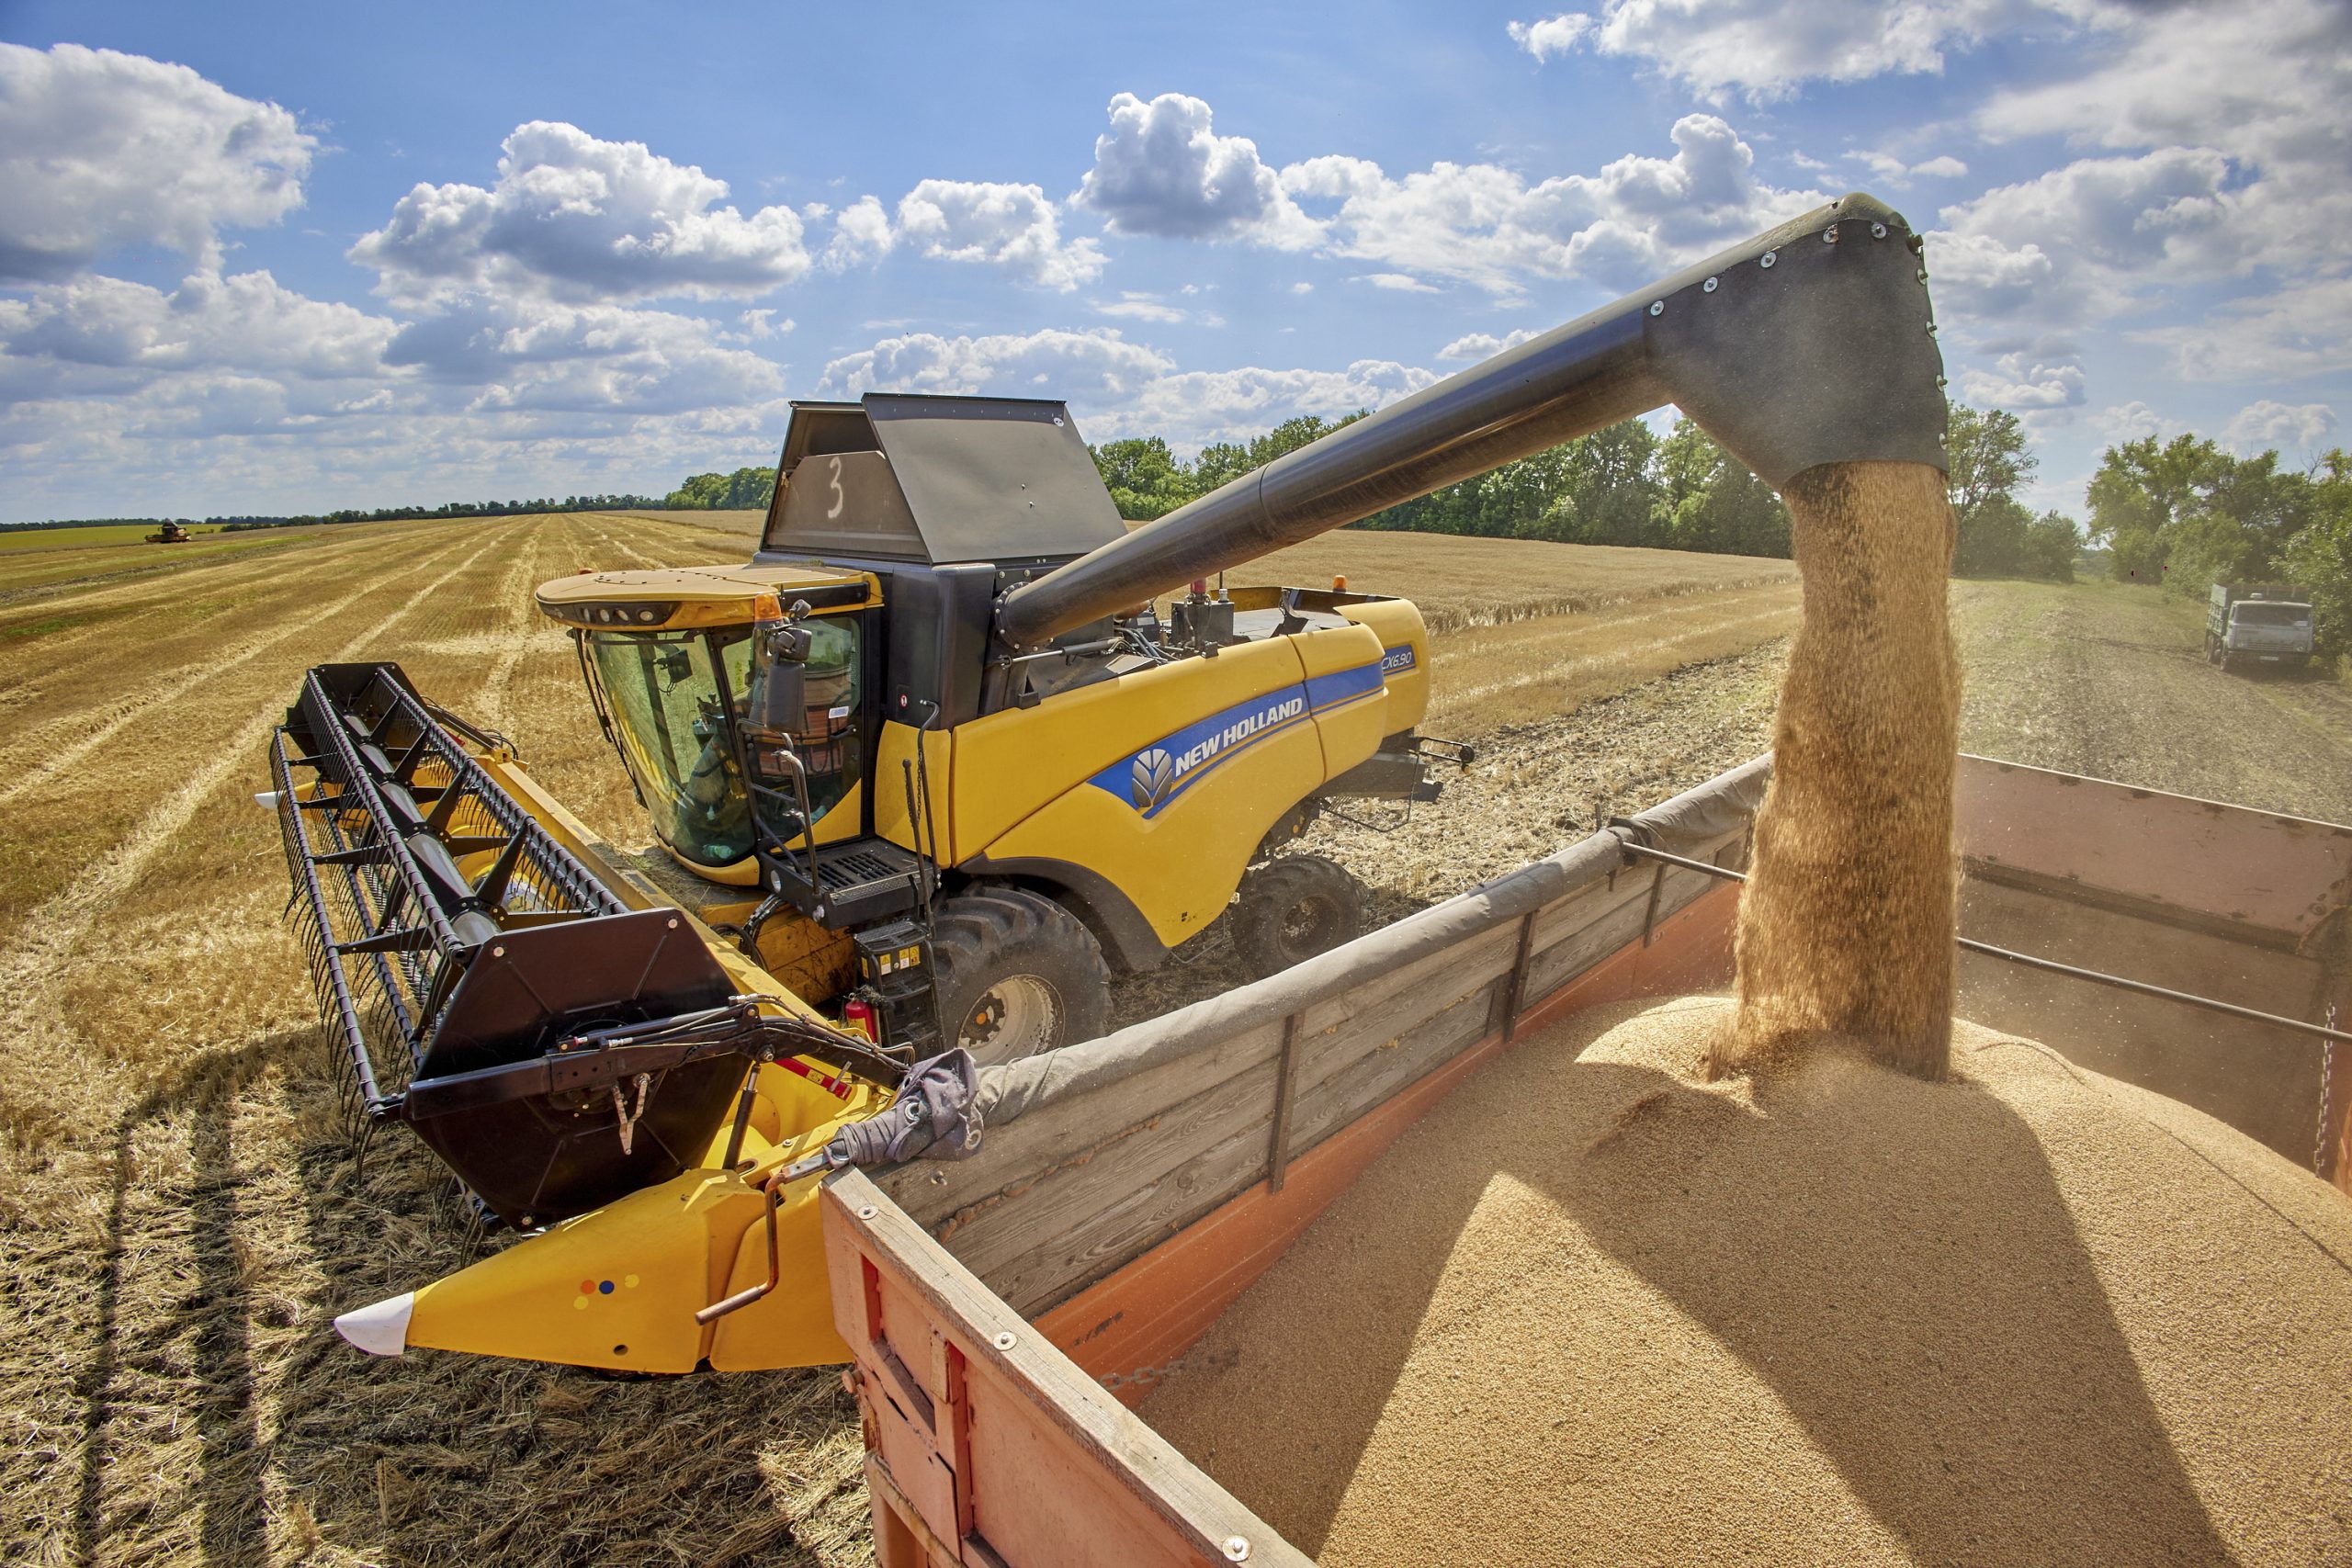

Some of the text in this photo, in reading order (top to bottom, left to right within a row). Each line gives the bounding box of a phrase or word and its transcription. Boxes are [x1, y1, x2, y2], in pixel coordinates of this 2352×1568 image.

[828, 456, 843, 519] 3
[1176, 697, 1303, 777] NEW HOLLAND
